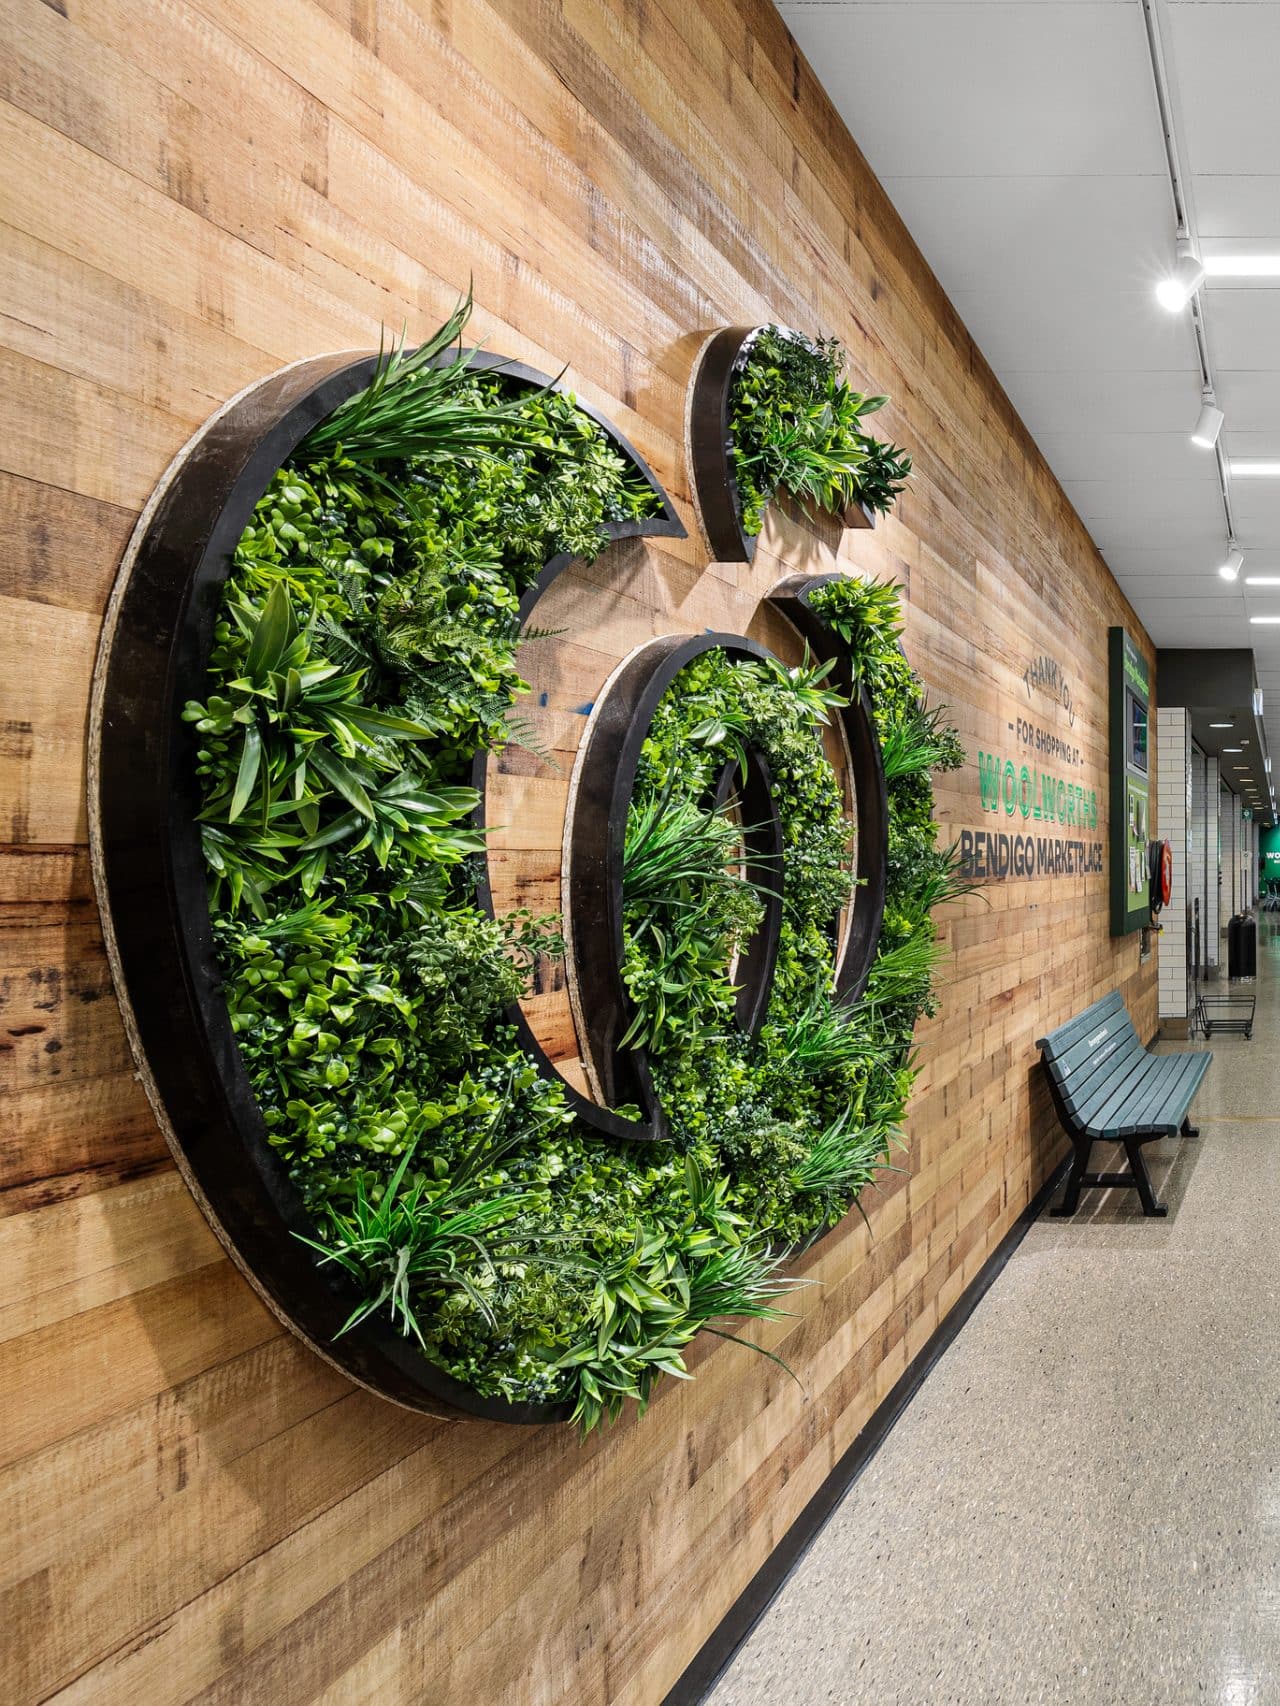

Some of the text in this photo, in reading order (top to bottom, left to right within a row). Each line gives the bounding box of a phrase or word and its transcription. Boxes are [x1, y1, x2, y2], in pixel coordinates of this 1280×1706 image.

[1023, 656, 1058, 699] THANK
[1017, 717, 1080, 766] FOR SHOPPING AT
[978, 751, 1098, 832] WOOLWORTHS
[960, 829, 1103, 878] BENDIGO MARKETPLACE
